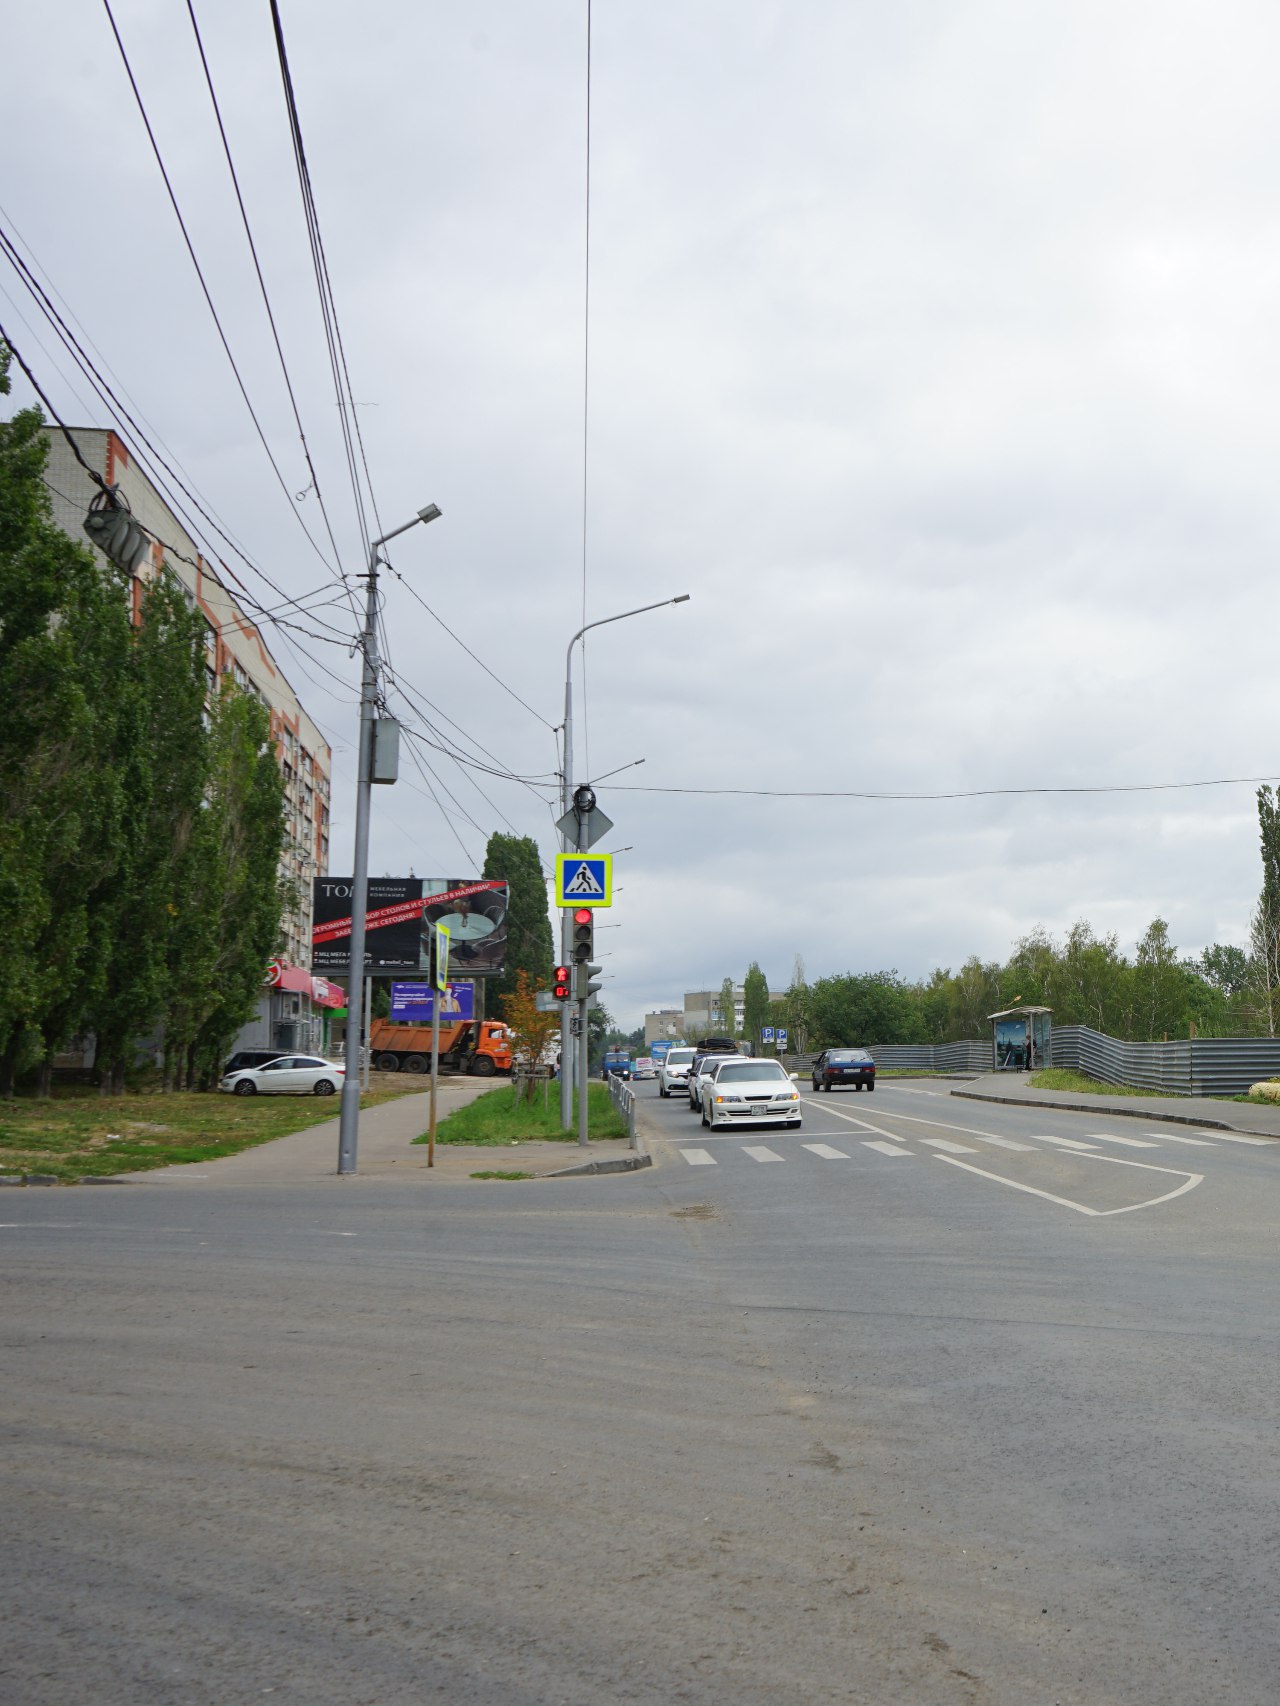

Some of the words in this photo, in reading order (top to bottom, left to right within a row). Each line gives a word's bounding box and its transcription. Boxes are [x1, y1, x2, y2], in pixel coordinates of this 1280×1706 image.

[380, 903, 411, 916] СТОЛОВ
[417, 894, 449, 907] СТУЛЬЕВ
[380, 911, 415, 926] СЕГОДНЯ!
